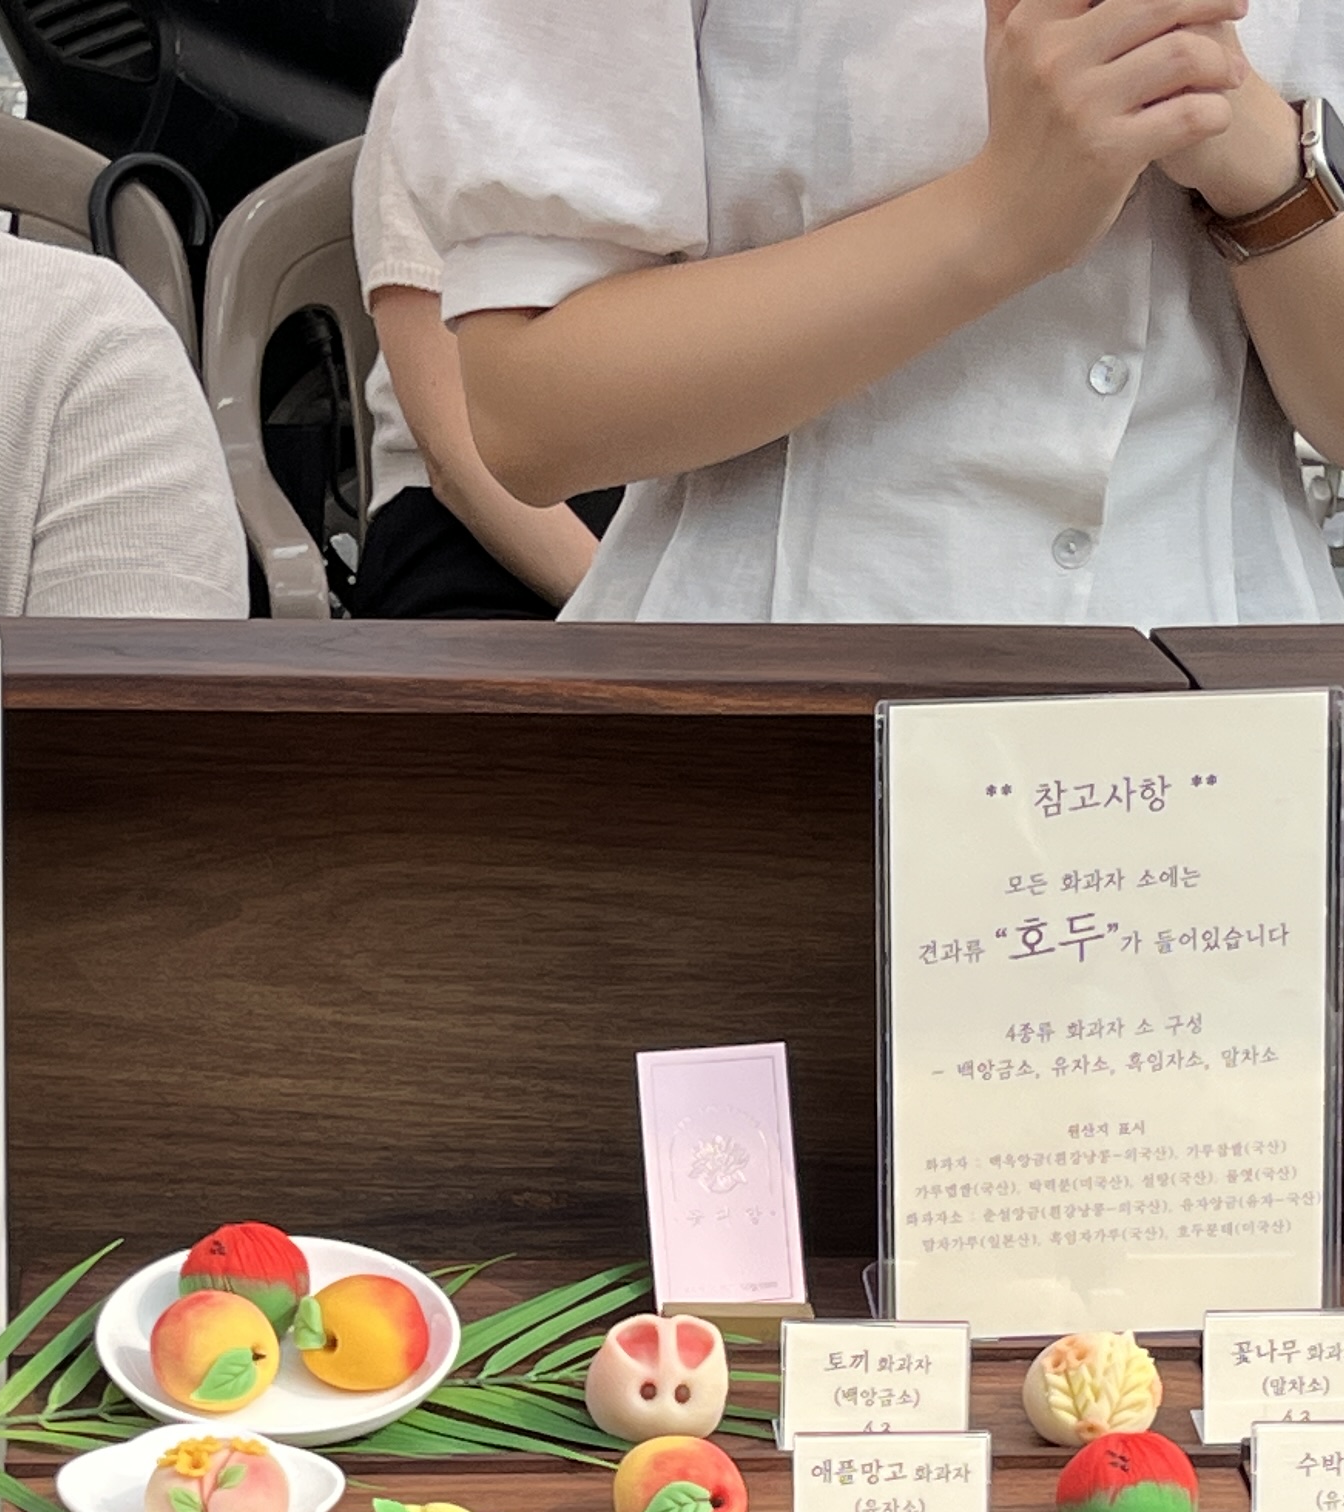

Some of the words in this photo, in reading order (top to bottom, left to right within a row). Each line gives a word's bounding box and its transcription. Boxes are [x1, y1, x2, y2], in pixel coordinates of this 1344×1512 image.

[1034, 775, 1172, 818] 참고사항
[1004, 873, 1049, 896] 모든
[1060, 868, 1125, 894] 화과자
[1136, 865, 1201, 889] 소에는
[918, 938, 986, 965] 견과류
[1155, 923, 1291, 954] 들어있습니다
[1005, 1020, 1054, 1044] 4종류
[1066, 1017, 1125, 1041] 화과자
[1135, 1018, 1155, 1038] 소
[1165, 1013, 1204, 1038] 구성
[1051, 1053, 1116, 1078] 유자소,
[1221, 1045, 1280, 1070] 말차소
[1068, 1122, 1109, 1138] 원산지
[1119, 1120, 1146, 1136] 표시
[825, 1350, 869, 1374] 토끼
[876, 1354, 932, 1375] 화과자
[1230, 1339, 1301, 1366] 꽃나무
[811, 1459, 908, 1485] 애플망고
[913, 1464, 971, 1483] 화과자
[1296, 1451, 1344, 1477] 수박
